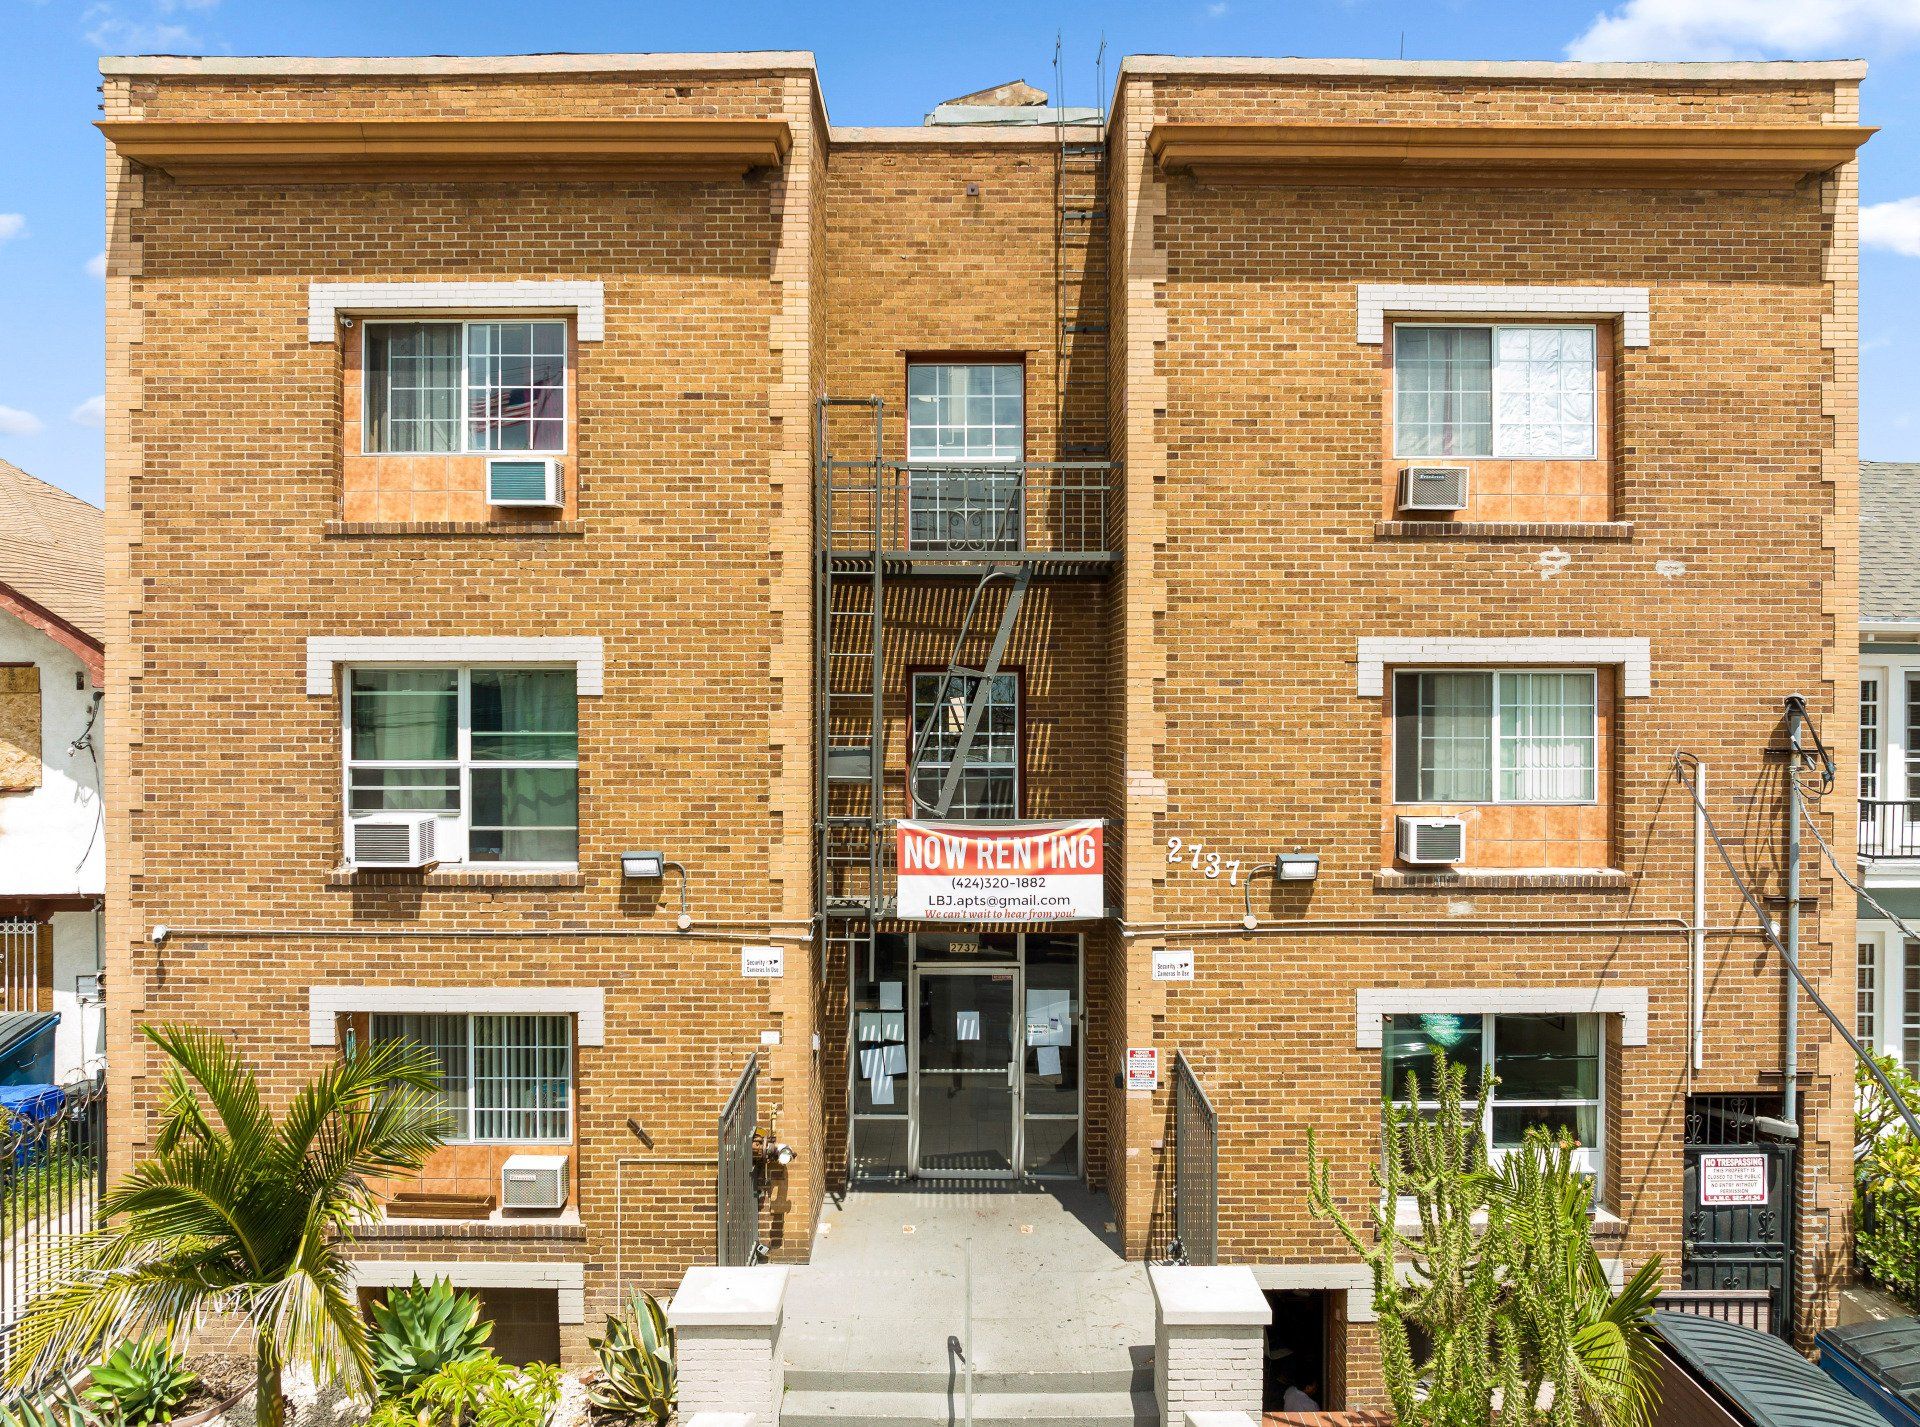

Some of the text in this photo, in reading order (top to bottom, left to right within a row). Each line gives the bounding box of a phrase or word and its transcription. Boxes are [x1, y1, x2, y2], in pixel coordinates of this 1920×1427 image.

[904, 835, 1095, 870] NOW RENTING
[1168, 837, 1240, 886] 2737
[951, 877, 1046, 890] (424)320-1882
[928, 895, 1070, 908] LBJ.apts@gmail.com
[925, 908, 1076, 921] We can't wait to hear from you!
[950, 943, 977, 952] 2737
[1705, 1157, 1763, 1167] NO TRESPASSING
